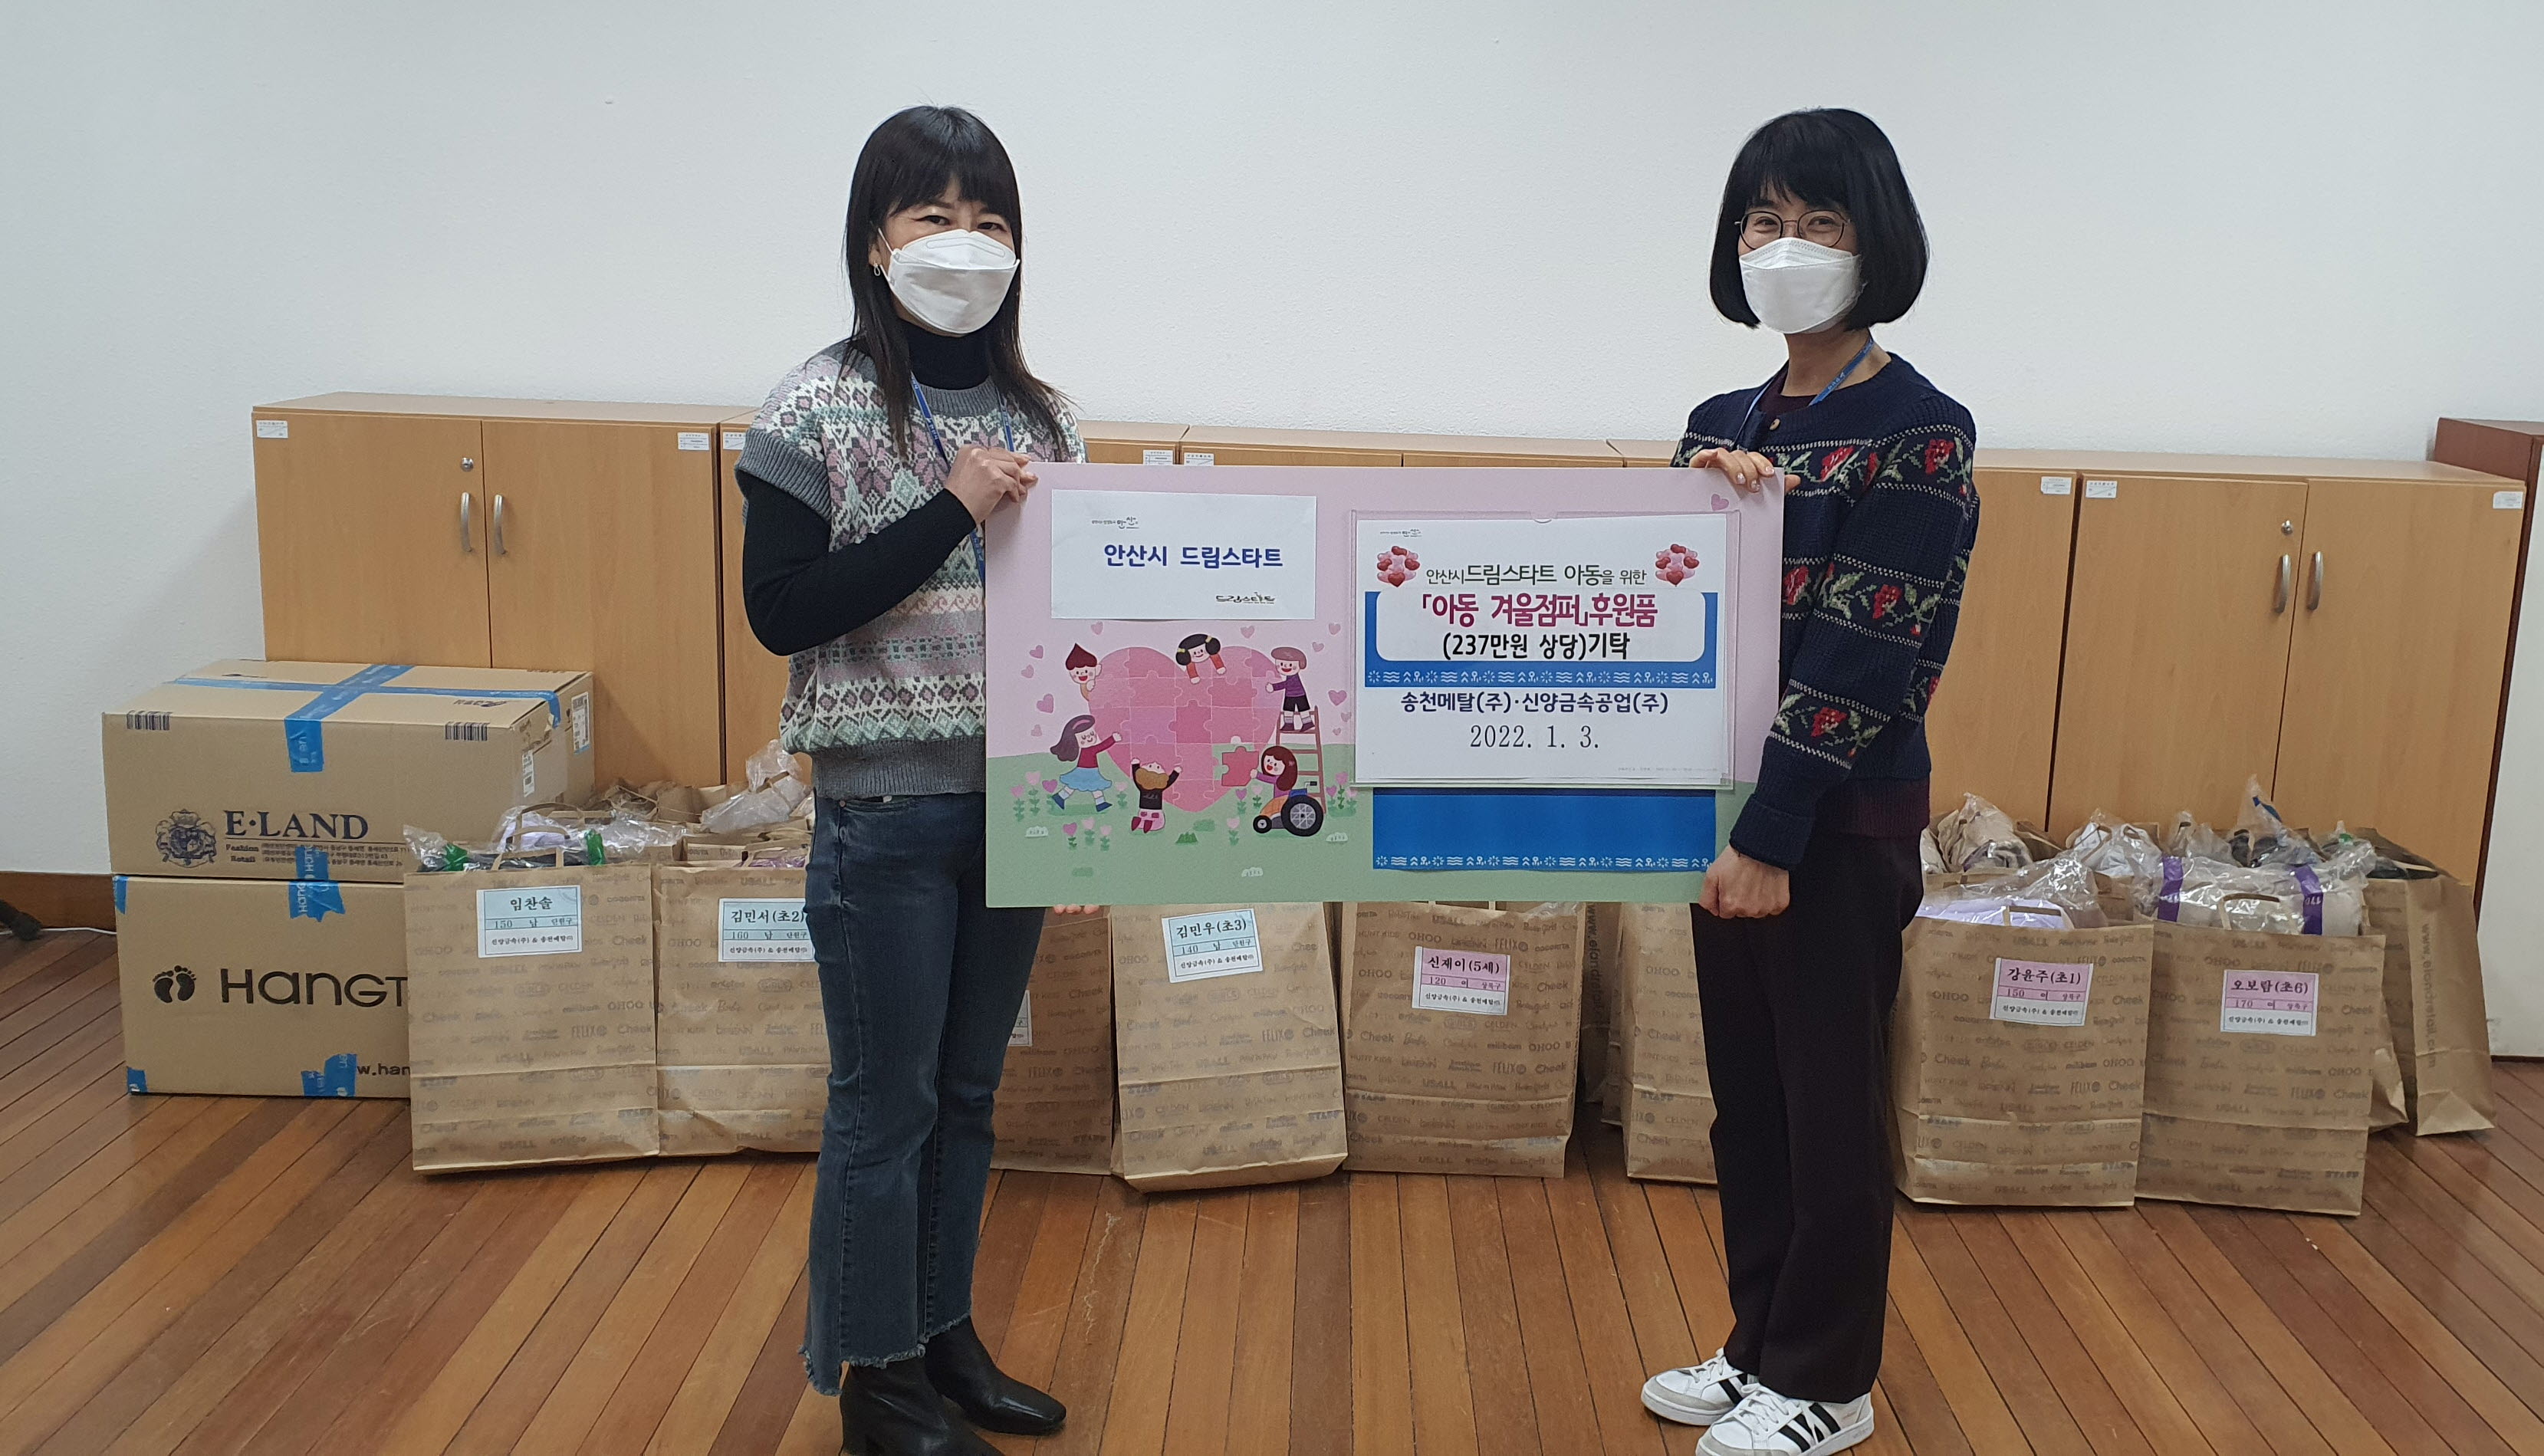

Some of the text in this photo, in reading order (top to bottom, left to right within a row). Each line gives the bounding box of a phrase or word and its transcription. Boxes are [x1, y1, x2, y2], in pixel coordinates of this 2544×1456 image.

[1103, 544, 1284, 570] 안산시 드림스타트
[1425, 564, 1648, 587] 안산시드림스타트 아동을 위한
[1443, 632, 1631, 662] (237만원 상당)기탁
[1469, 724, 1600, 749] 2022. 1. 3.
[511, 896, 553, 912] 임찬솔
[495, 919, 513, 928] 150
[529, 917, 538, 928] 남
[731, 909, 804, 924] 김민서(초2)
[731, 931, 749, 939] 160
[764, 930, 774, 940] 남
[1176, 918, 1247, 939] 김민우(초3)
[612, 935, 647, 945] Cheek
[1408, 932, 1442, 943] OHOO
[1182, 945, 1199, 955] 140
[1212, 940, 1221, 951] 남
[1428, 955, 1500, 975] 신재이(5세)
[1359, 968, 1393, 978] OHOO
[2007, 967, 2082, 985] 강윤주(초1)
[1429, 976, 1447, 985] 120
[1537, 980, 1569, 992] Cheek
[1068, 986, 1104, 1000] Cheek
[2007, 988, 2025, 998] 150
[607, 1001, 645, 1011] OHOO
[2235, 999, 2253, 1007] 170
[1302, 1027, 1336, 1038] Cheek
[1360, 1030, 1395, 1044] Cheek
[1528, 1041, 1560, 1052] OHOO
[1934, 1053, 1970, 1067] Cheek
[1535, 1062, 1566, 1075] Cheek
